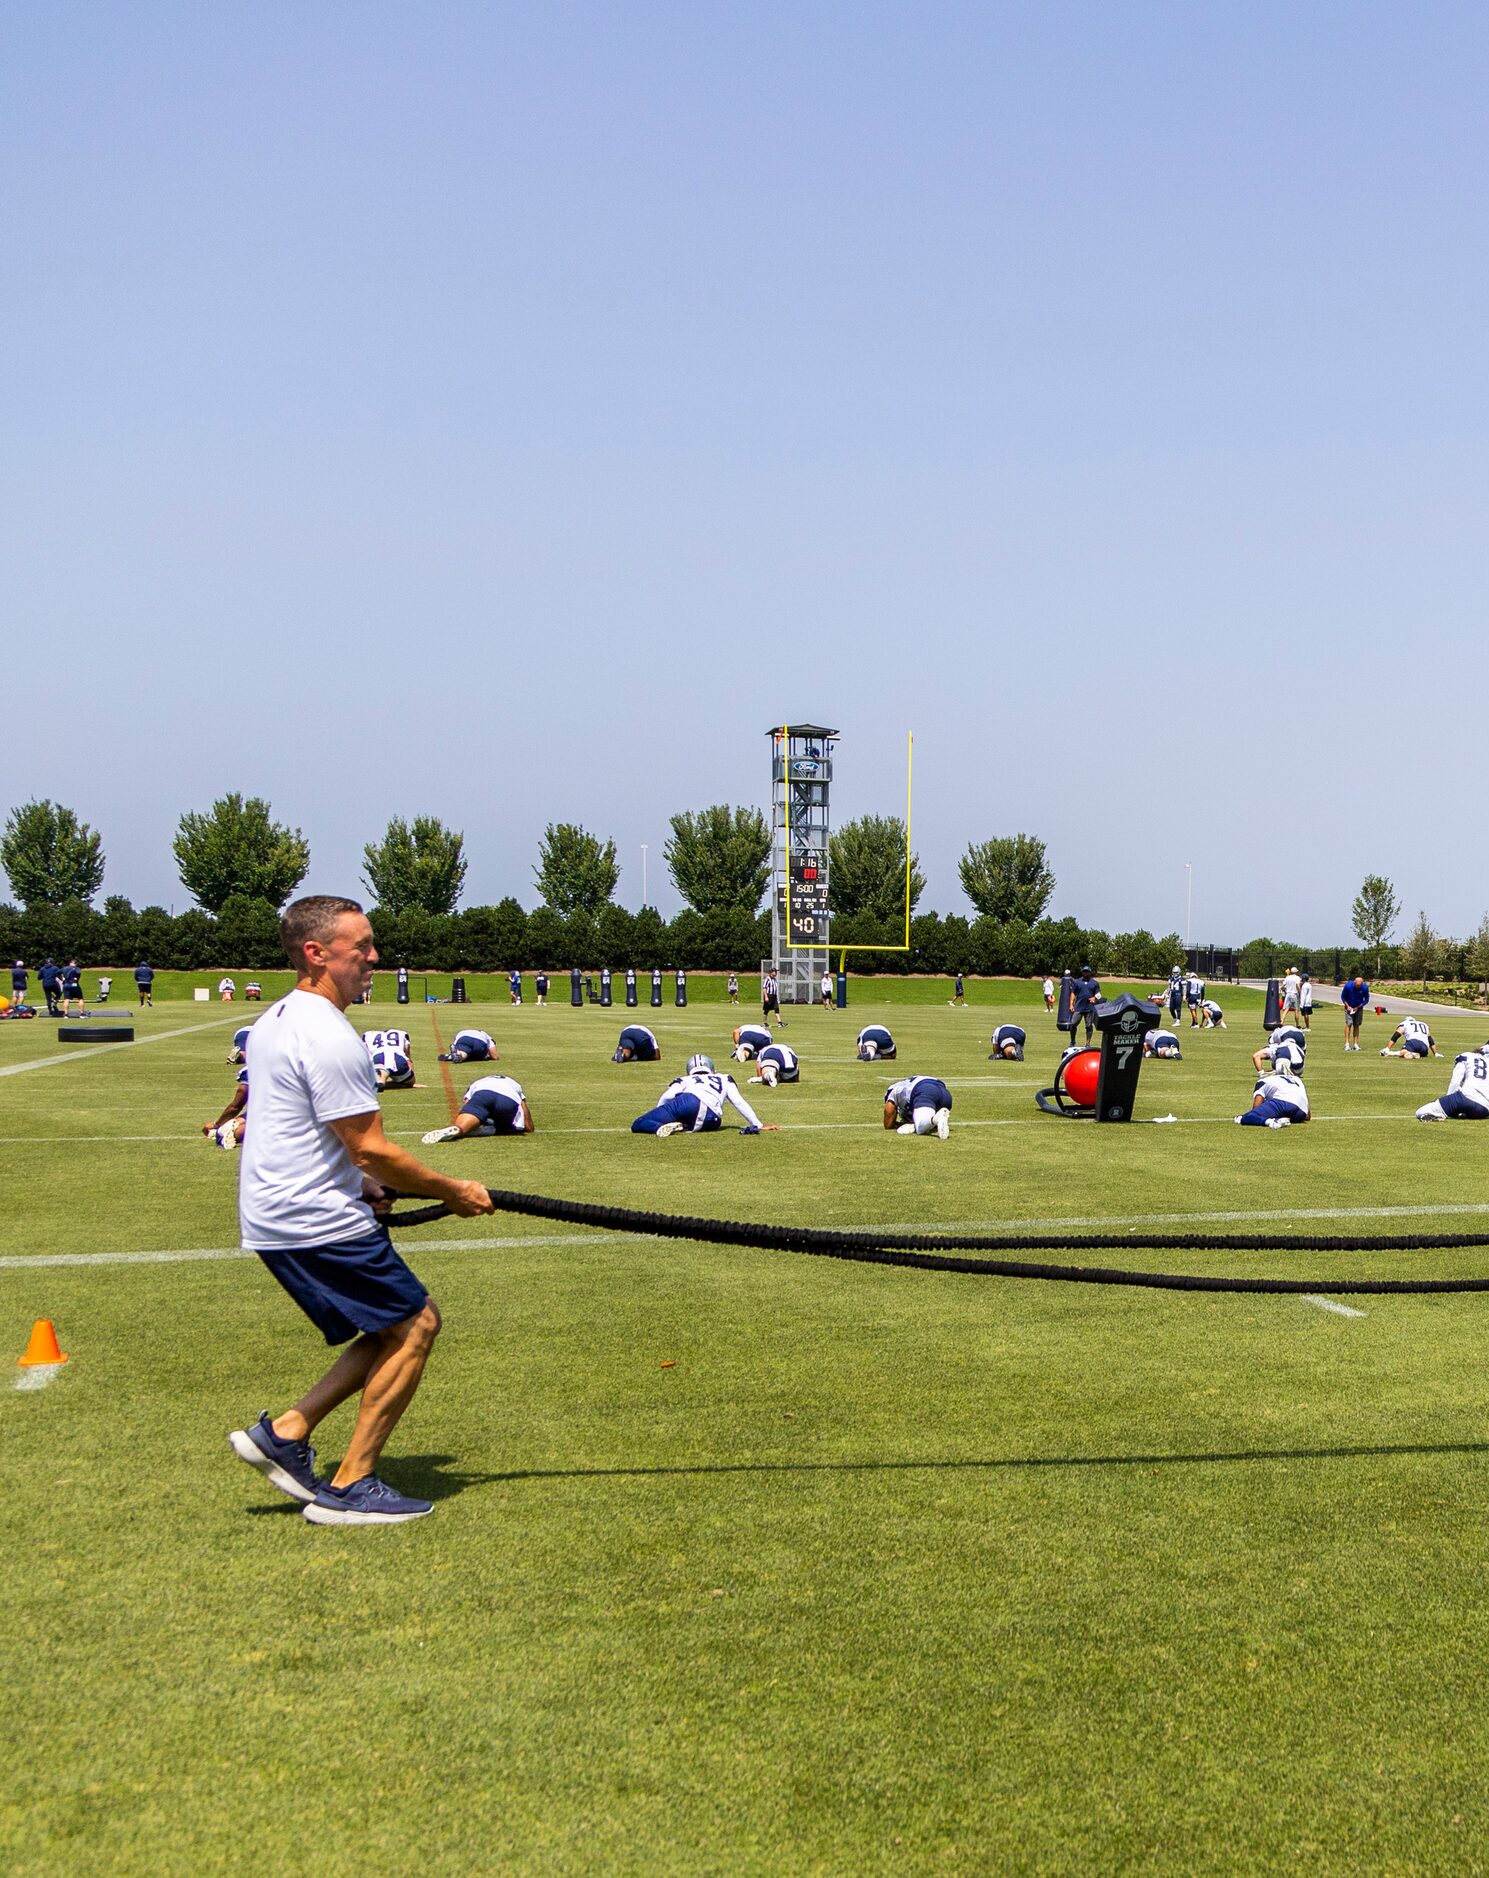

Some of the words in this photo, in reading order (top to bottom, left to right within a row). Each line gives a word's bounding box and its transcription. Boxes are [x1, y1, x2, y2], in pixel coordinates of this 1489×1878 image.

[793, 917, 815, 933] 40
[1410, 1022, 1427, 1034] 70
[372, 1031, 400, 1049] 49
[1115, 1046, 1135, 1070] 7
[691, 1074, 723, 1094] 19
